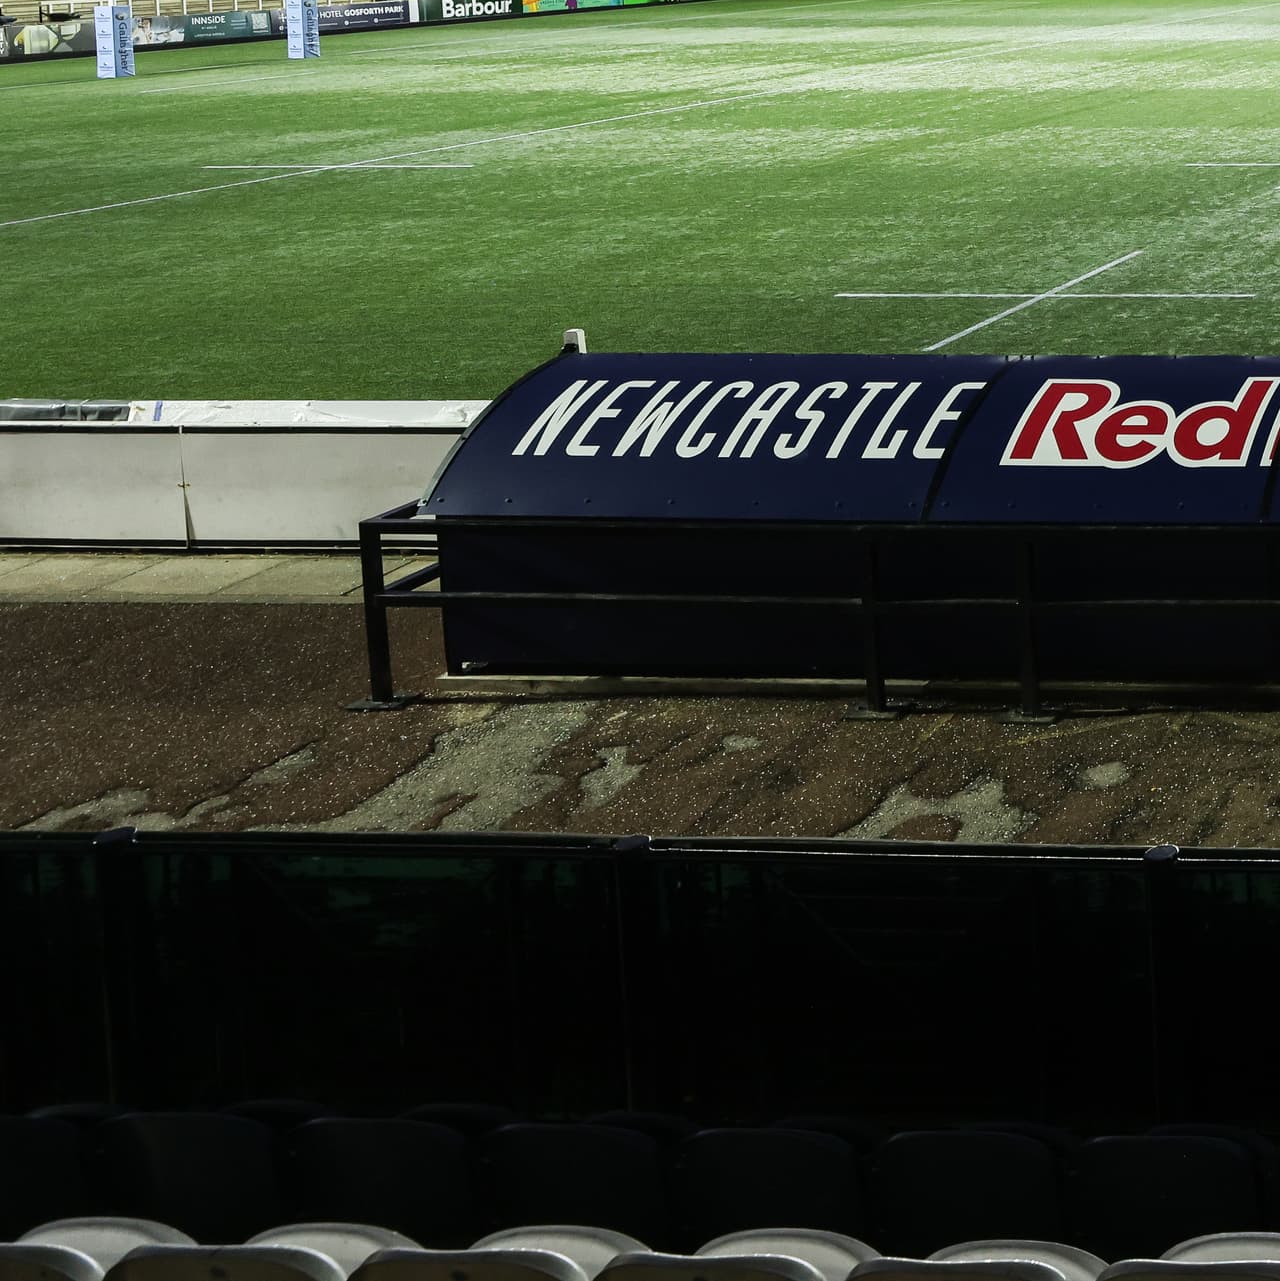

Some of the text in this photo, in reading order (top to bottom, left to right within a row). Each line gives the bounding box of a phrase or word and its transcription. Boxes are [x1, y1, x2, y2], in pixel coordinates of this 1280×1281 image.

[320, 5, 404, 19] HOTEL GOSFORTH PARK
[118, 22, 130, 71] Gallagher
[512, 380, 986, 459] NEWCASTLE
